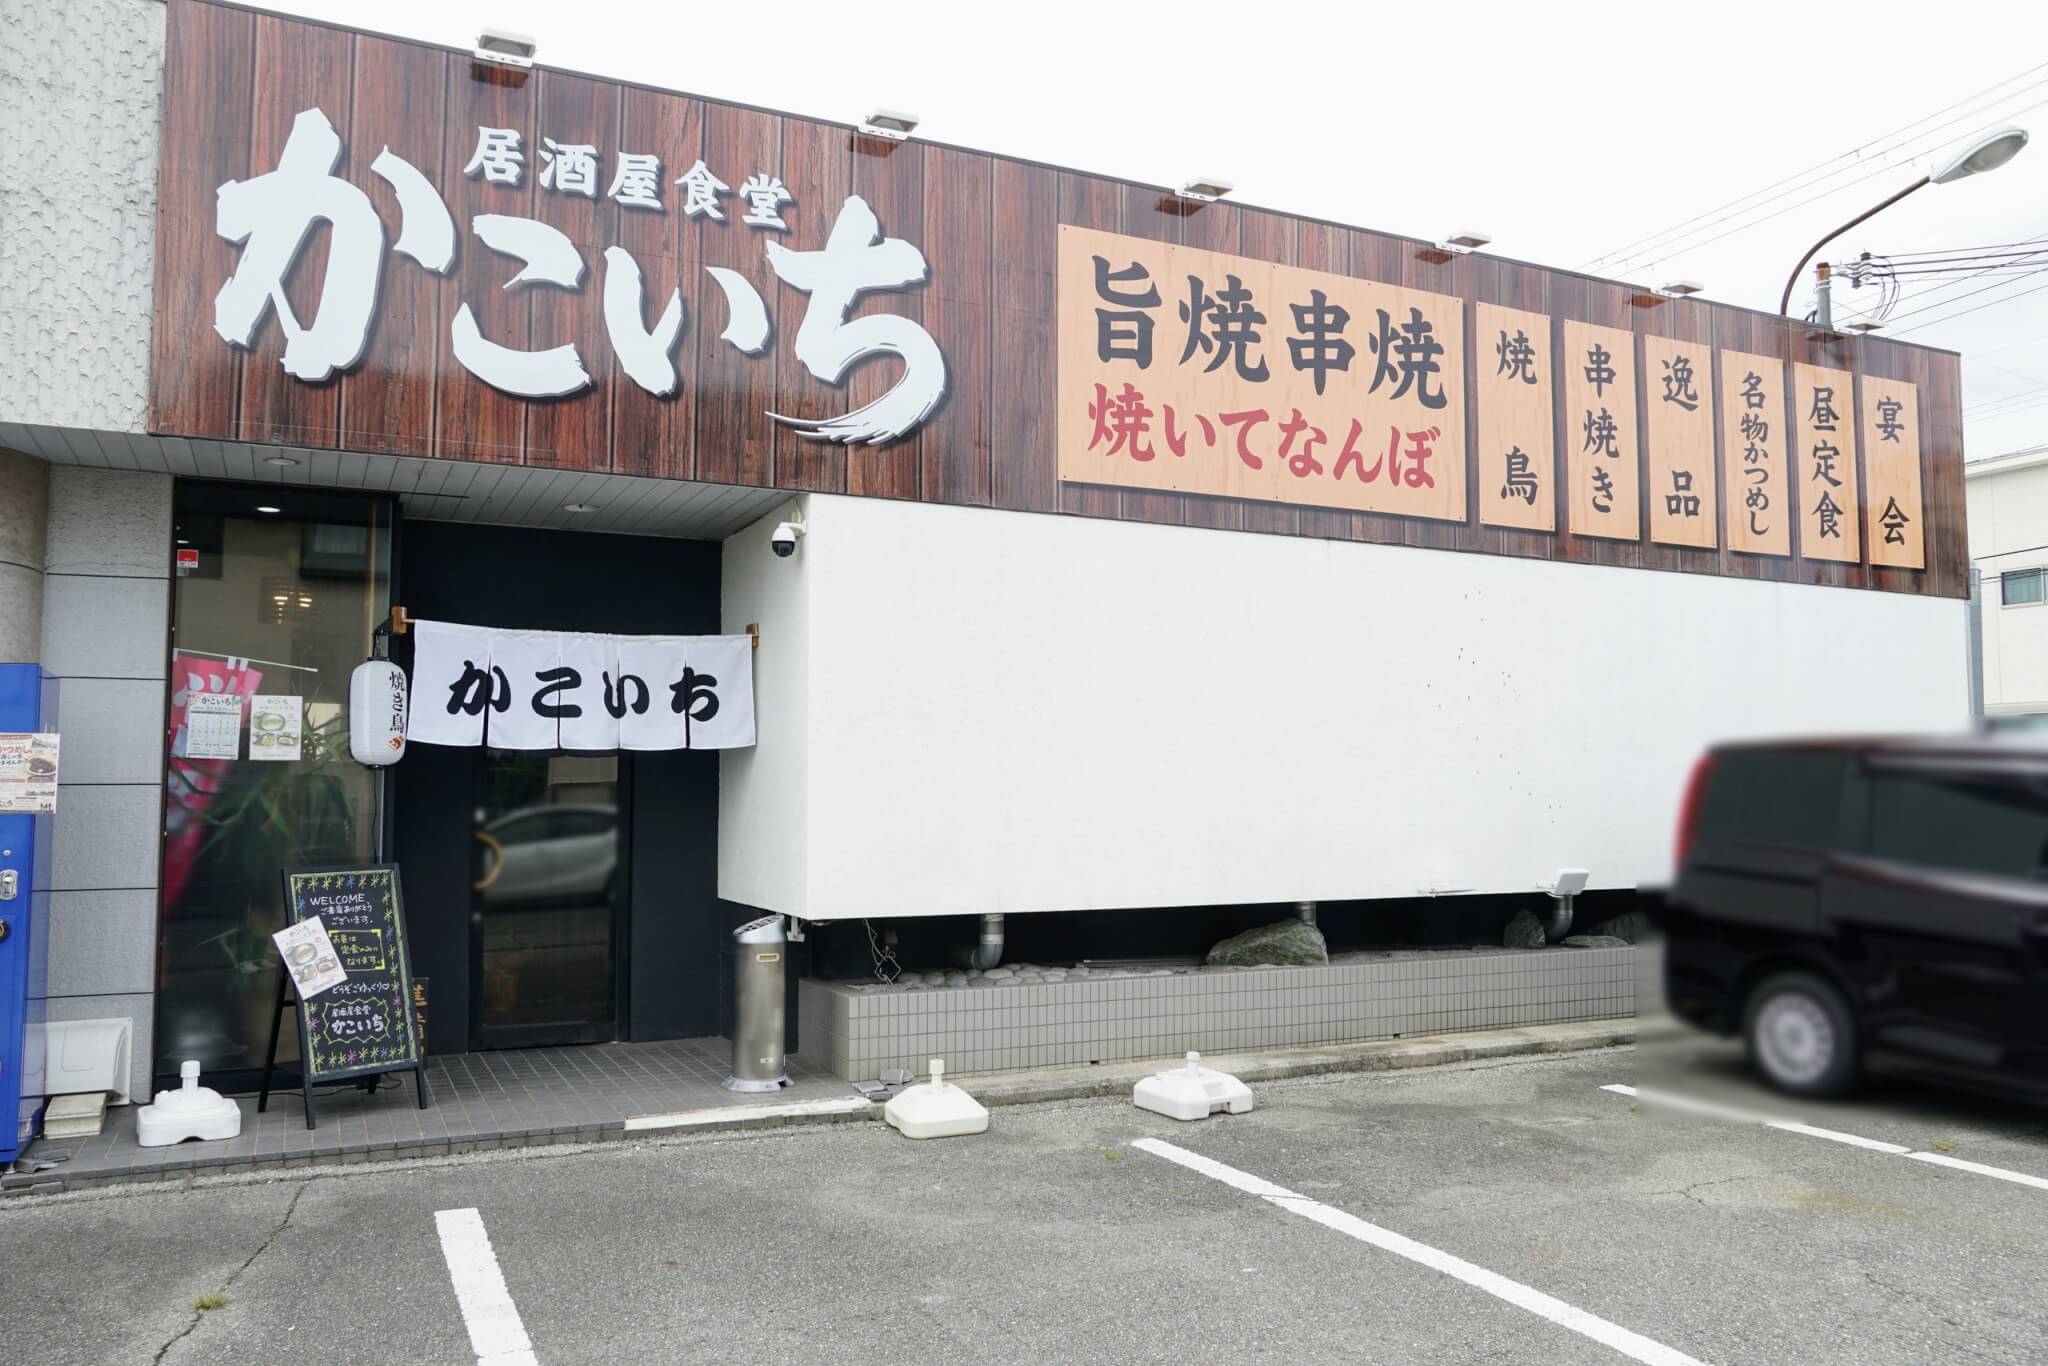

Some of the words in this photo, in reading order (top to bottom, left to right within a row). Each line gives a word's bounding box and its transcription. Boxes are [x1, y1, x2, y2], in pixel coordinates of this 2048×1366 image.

[464, 125, 796, 231] 居酒屋食堂
[214, 106, 946, 445] かこいち
[1092, 255, 1448, 409] 旨焼串焼
[1088, 382, 1441, 489] 焼いてなんぼ
[1496, 329, 1538, 506] 焼鳥
[1583, 343, 1620, 514] 串焼き
[1661, 355, 1700, 518] 逸品
[1739, 371, 1770, 536] 名物かつめし
[1808, 386, 1843, 539] 昼定食
[1876, 395, 1911, 546] 宴会
[389, 671, 405, 734] 焼き鳥
[446, 660, 720, 722] かこいち
[310, 893, 365, 905] WELCOME
[331, 1014, 384, 1035] かこいち
